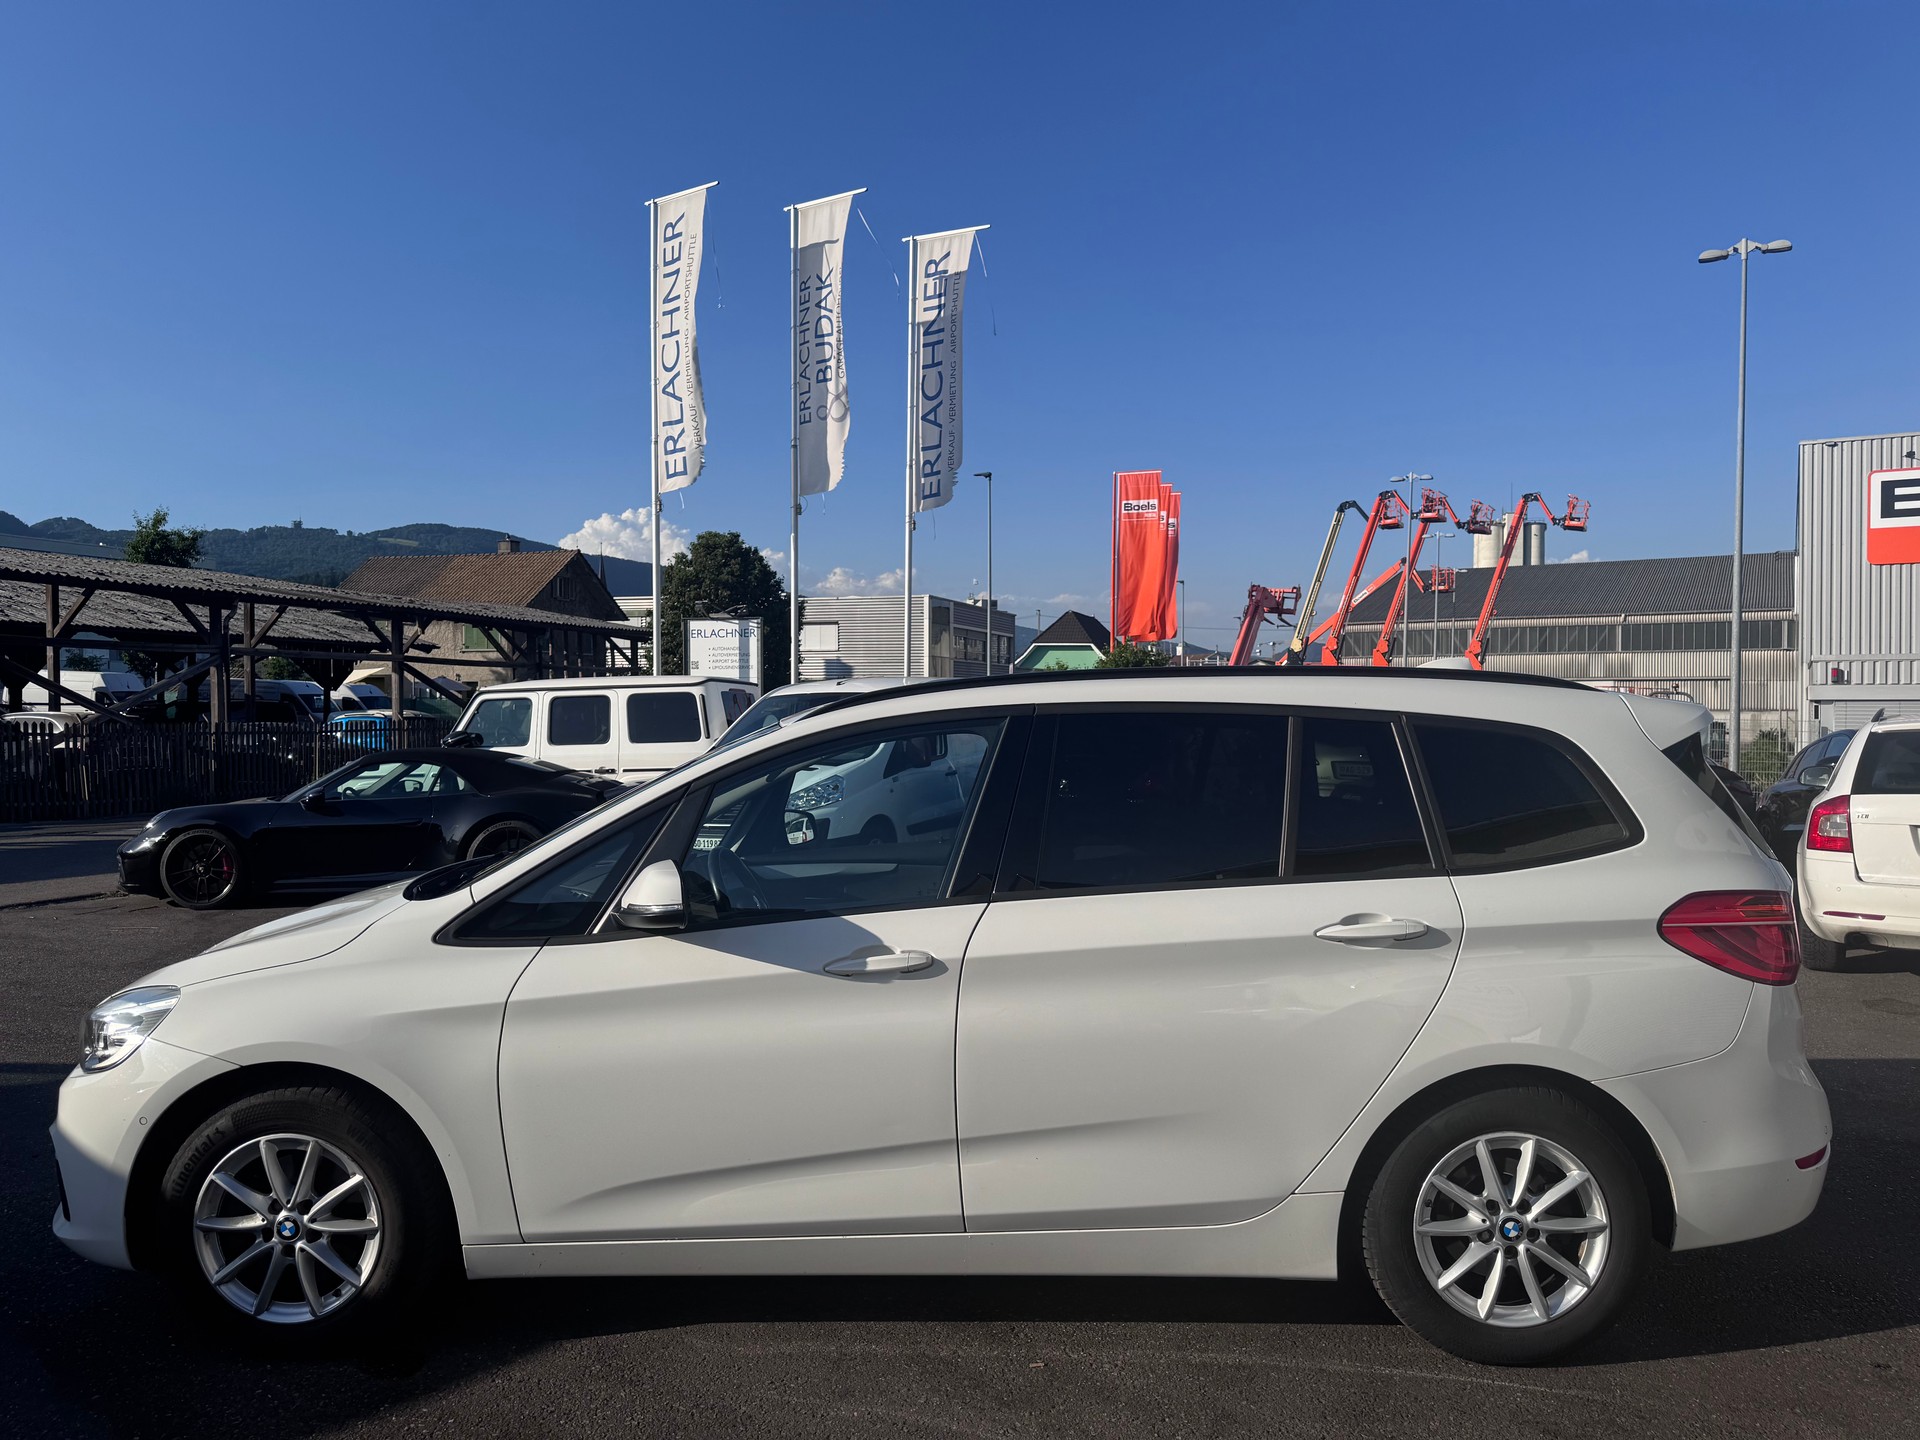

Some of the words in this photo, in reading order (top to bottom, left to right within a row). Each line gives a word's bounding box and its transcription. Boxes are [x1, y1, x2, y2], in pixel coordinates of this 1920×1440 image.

[683, 233, 698, 321] AIRPORTSHUTTLE
[950, 270, 962, 354] AIRPORTSHUTTLE
[661, 212, 687, 479] ERLACHNER
[799, 275, 812, 425] ERLACHNER
[815, 267, 834, 384] BUDAK
[683, 327, 694, 397] VERMIETUNG
[920, 250, 951, 500] ERLACHNER
[948, 360, 957, 424] VERMIETUNG
[689, 403, 703, 449] VERKAUF
[816, 382, 849, 423] &
[947, 430, 956, 473] VERKAUF
[1124, 501, 1156, 511] Boels
[691, 629, 757, 638] ERLACHNER
